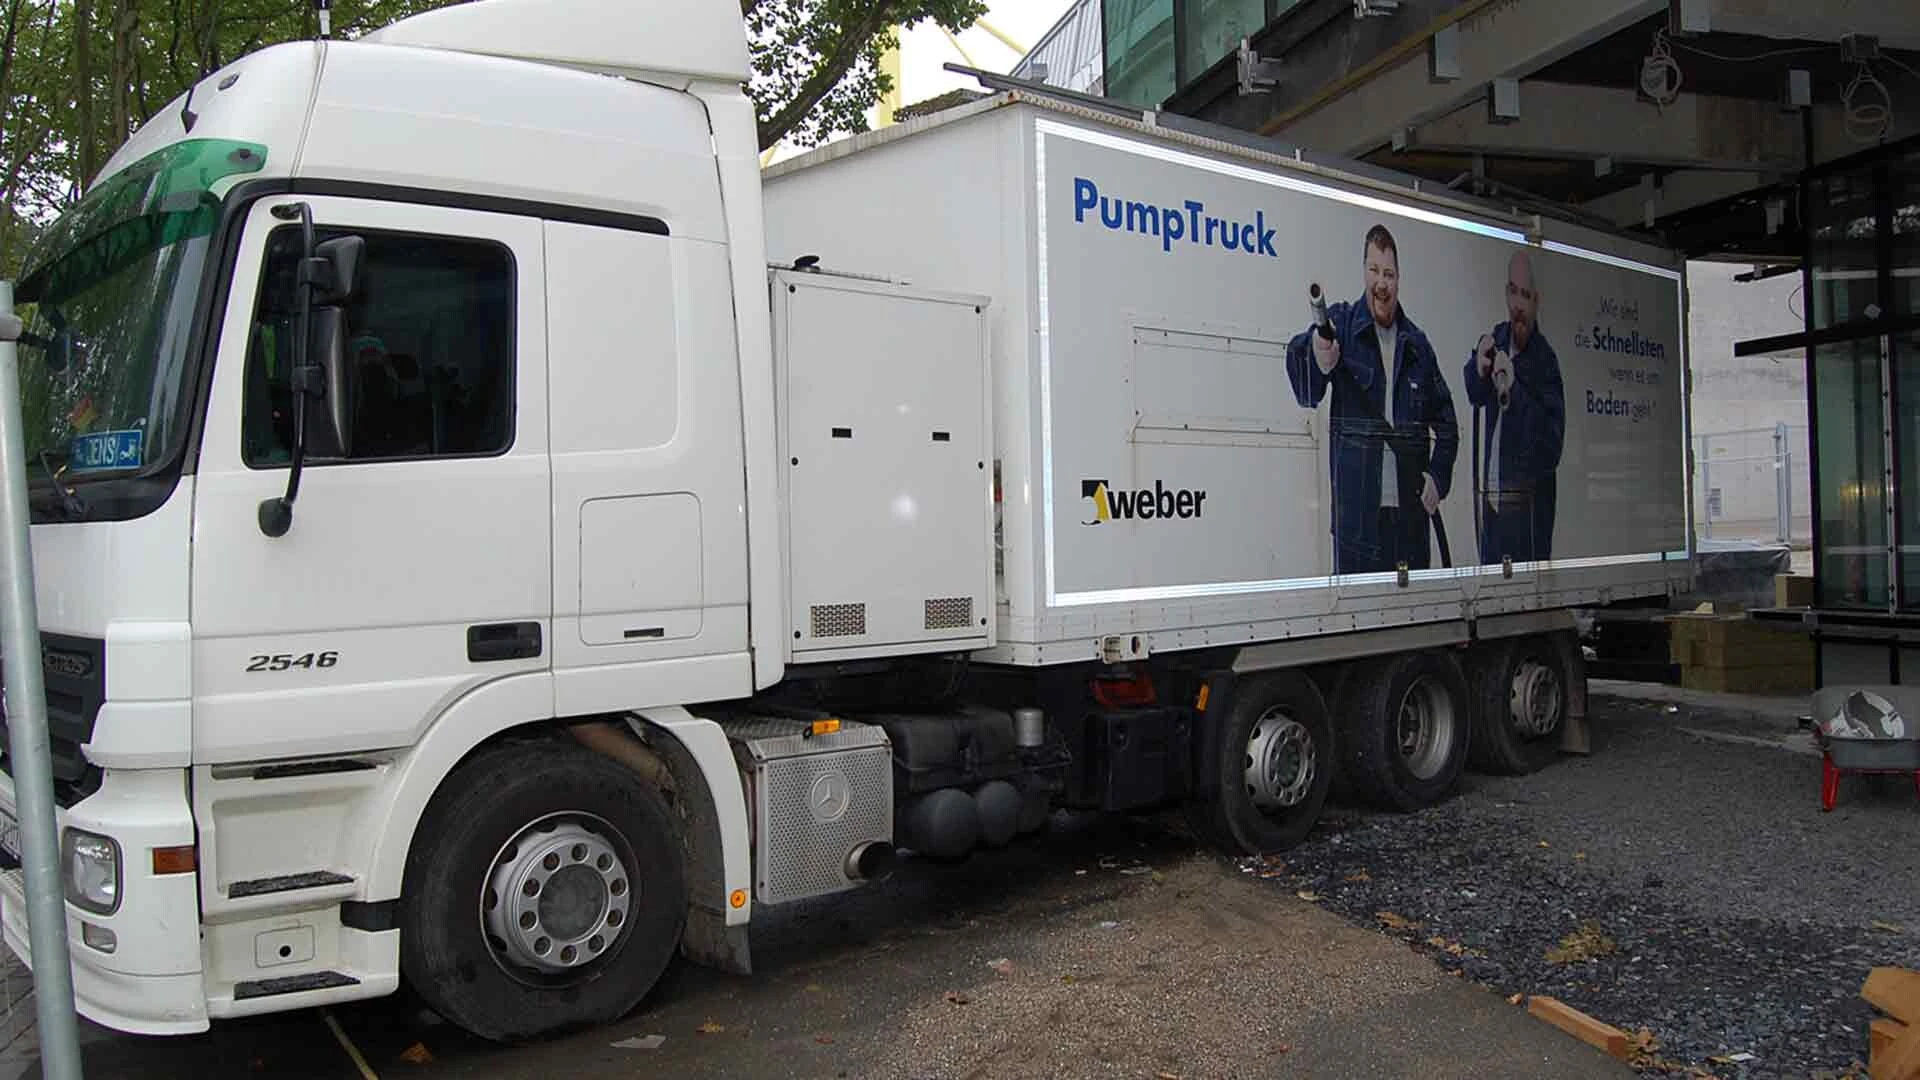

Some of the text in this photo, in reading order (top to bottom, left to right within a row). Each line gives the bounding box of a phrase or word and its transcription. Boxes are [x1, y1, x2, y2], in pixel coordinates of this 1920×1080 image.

[1074, 177, 1277, 257] PumpTruck
[1586, 389, 1629, 416] Boden
[1106, 479, 1206, 519] weber
[245, 651, 339, 672] 2546
